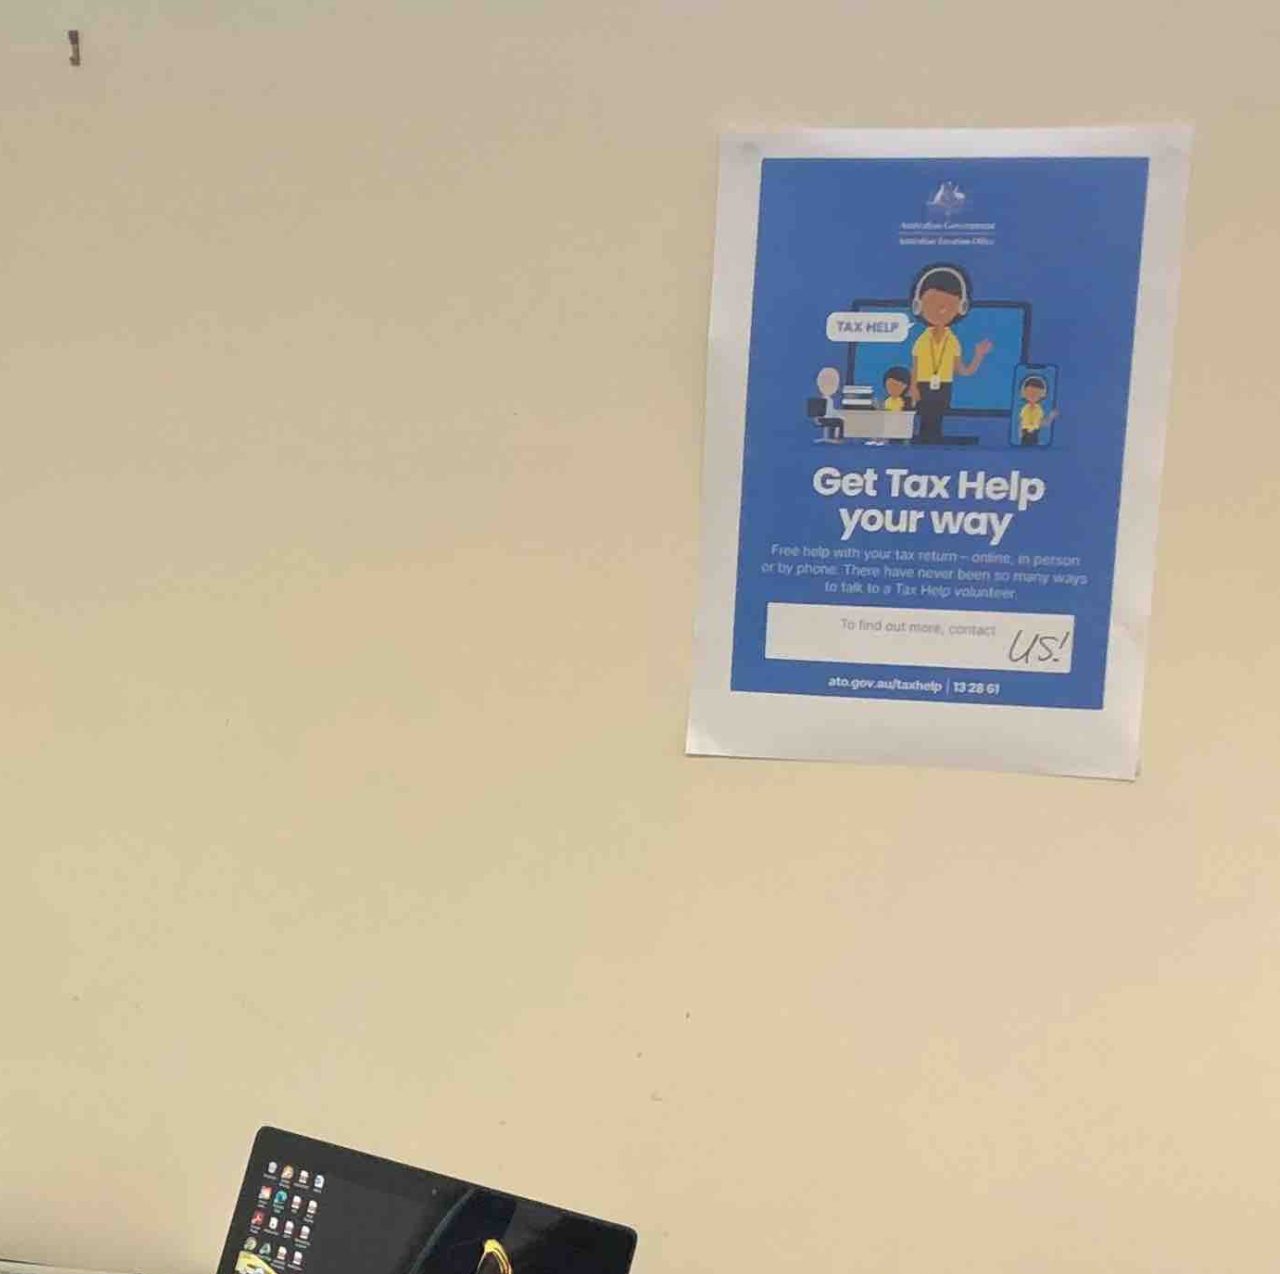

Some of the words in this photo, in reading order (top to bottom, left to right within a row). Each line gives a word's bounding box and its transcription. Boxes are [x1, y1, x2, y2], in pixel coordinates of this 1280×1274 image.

[836, 320, 863, 333] TAX
[866, 321, 899, 333] HELP
[813, 467, 878, 497] Get
[885, 468, 951, 499] Tax
[958, 470, 1046, 511] Help
[839, 508, 924, 541] your
[931, 511, 1013, 546] way
[771, 543, 800, 557] Free
[803, 545, 830, 559] help
[834, 547, 860, 559] with
[864, 549, 892, 561] your
[895, 550, 915, 561] tax
[918, 551, 957, 563] return
[1018, 554, 1030, 565] in
[1033, 555, 1080, 567] person
[761, 563, 773, 573] or
[778, 562, 793, 575] by
[844, 563, 880, 577] There
[884, 565, 915, 578] have
[918, 568, 954, 580] never
[958, 568, 991, 582] been
[994, 573, 1010, 583] so
[1013, 573, 1050, 585] many
[1053, 574, 1089, 586] ways
[825, 582, 837, 593] to
[842, 582, 863, 594] talk
[869, 582, 880, 594] to
[896, 583, 918, 596] Tax
[921, 584, 951, 598] Help
[841, 618, 855, 630] To
[858, 619, 882, 631] find
[885, 622, 907, 632] out
[909, 623, 945, 636] more,
[949, 625, 996, 636] contact
[828, 676, 943, 694] ato.gov.au/taxhelp
[953, 681, 967, 693] 13
[970, 682, 984, 694] 28
[986, 684, 1001, 695] 61
